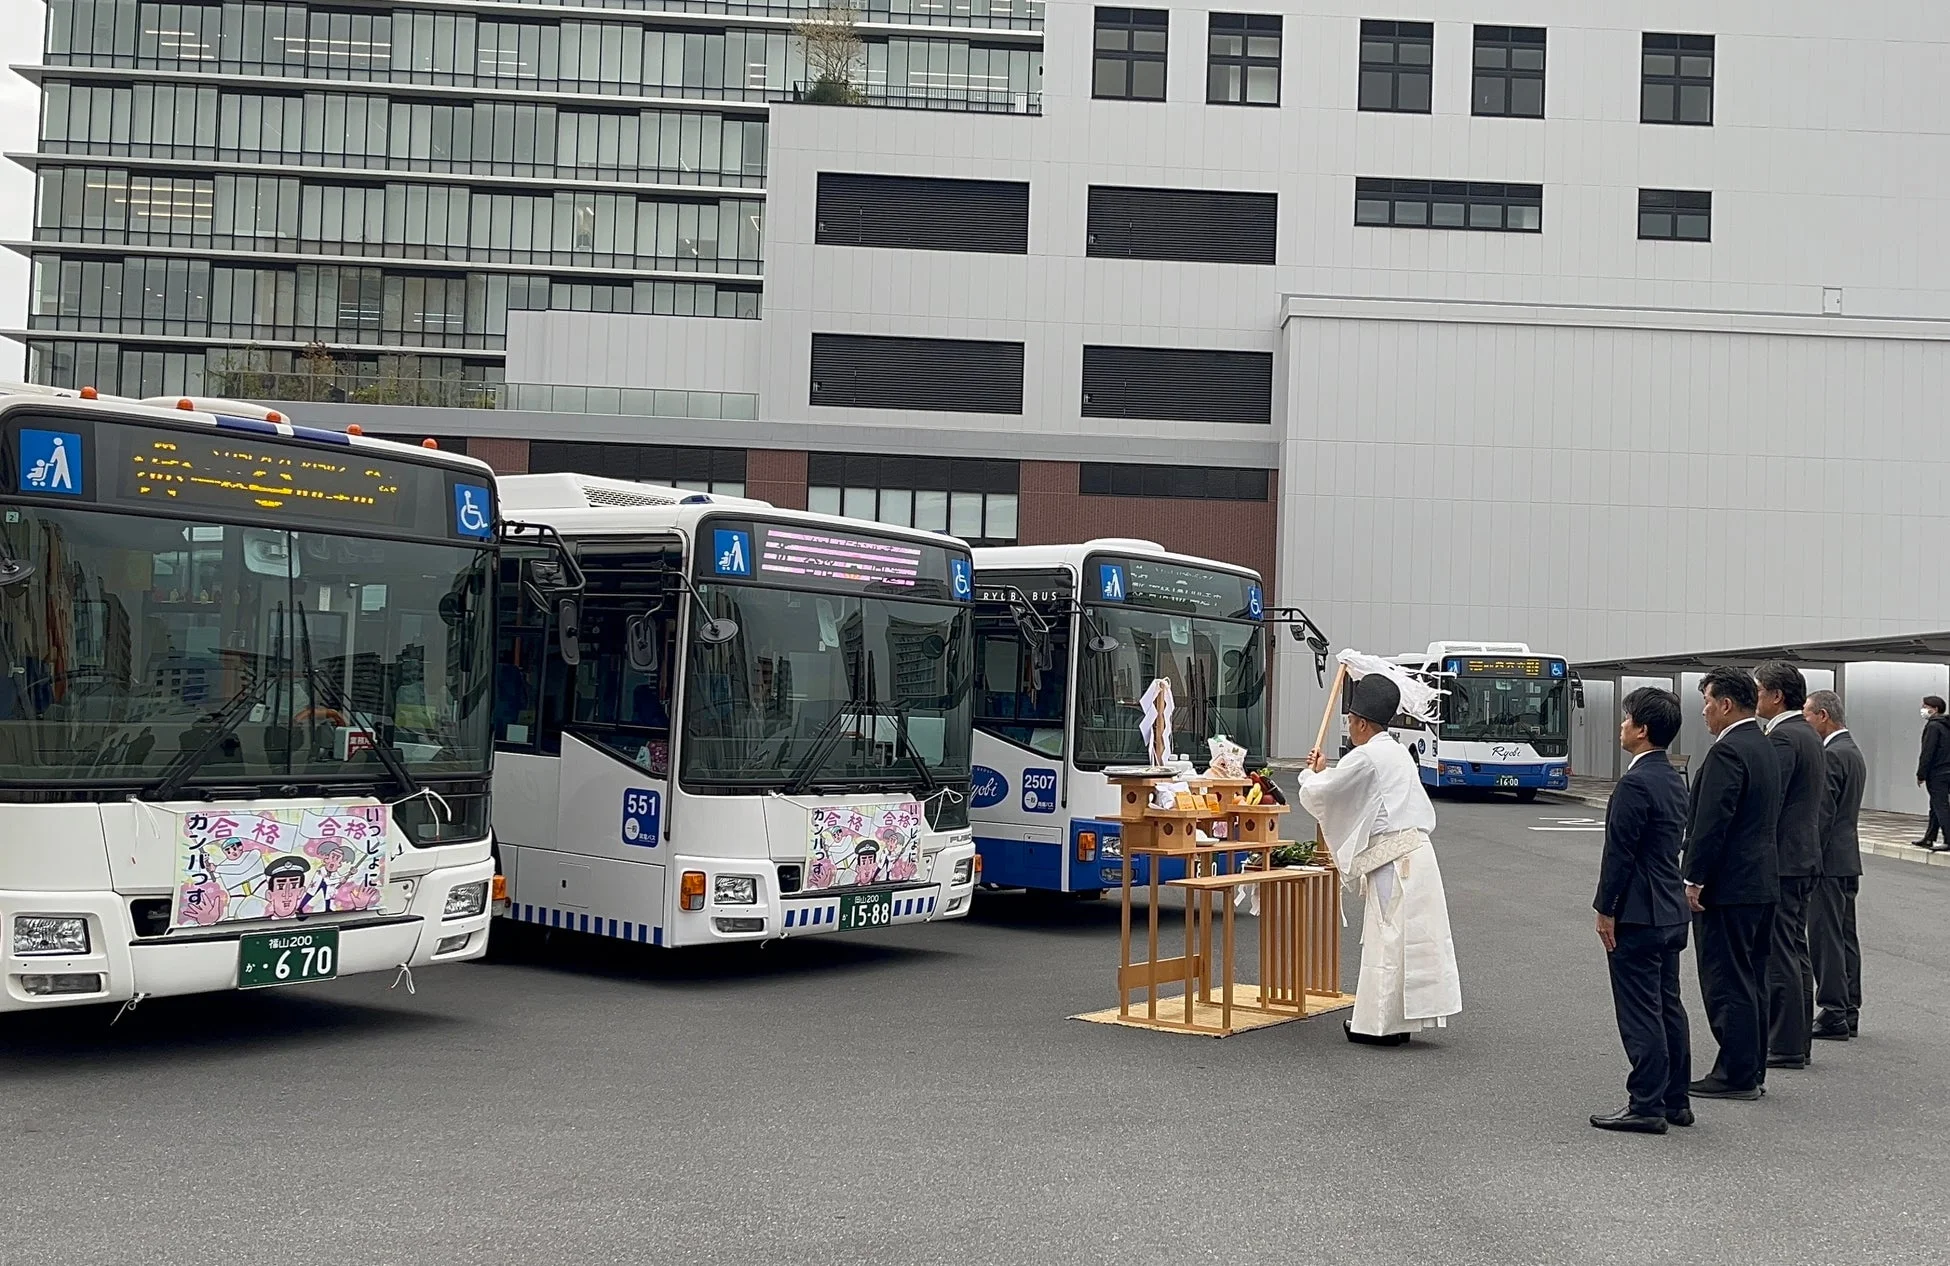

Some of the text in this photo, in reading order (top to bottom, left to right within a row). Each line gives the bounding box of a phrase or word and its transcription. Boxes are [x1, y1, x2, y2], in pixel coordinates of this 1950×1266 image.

[1032, 591, 1057, 601] BUS
[1491, 746, 1520, 761] Ryobi
[1024, 775, 1055, 789] 2507
[627, 794, 656, 816] 551
[318, 817, 366, 840] 合格
[824, 812, 863, 831] 合格
[882, 811, 910, 828] 合格
[207, 817, 280, 845] 合格
[908, 805, 919, 863] いっしょに
[365, 808, 380, 887] いっしょに
[850, 902, 890, 927] 15-88
[269, 935, 313, 949] 福山200
